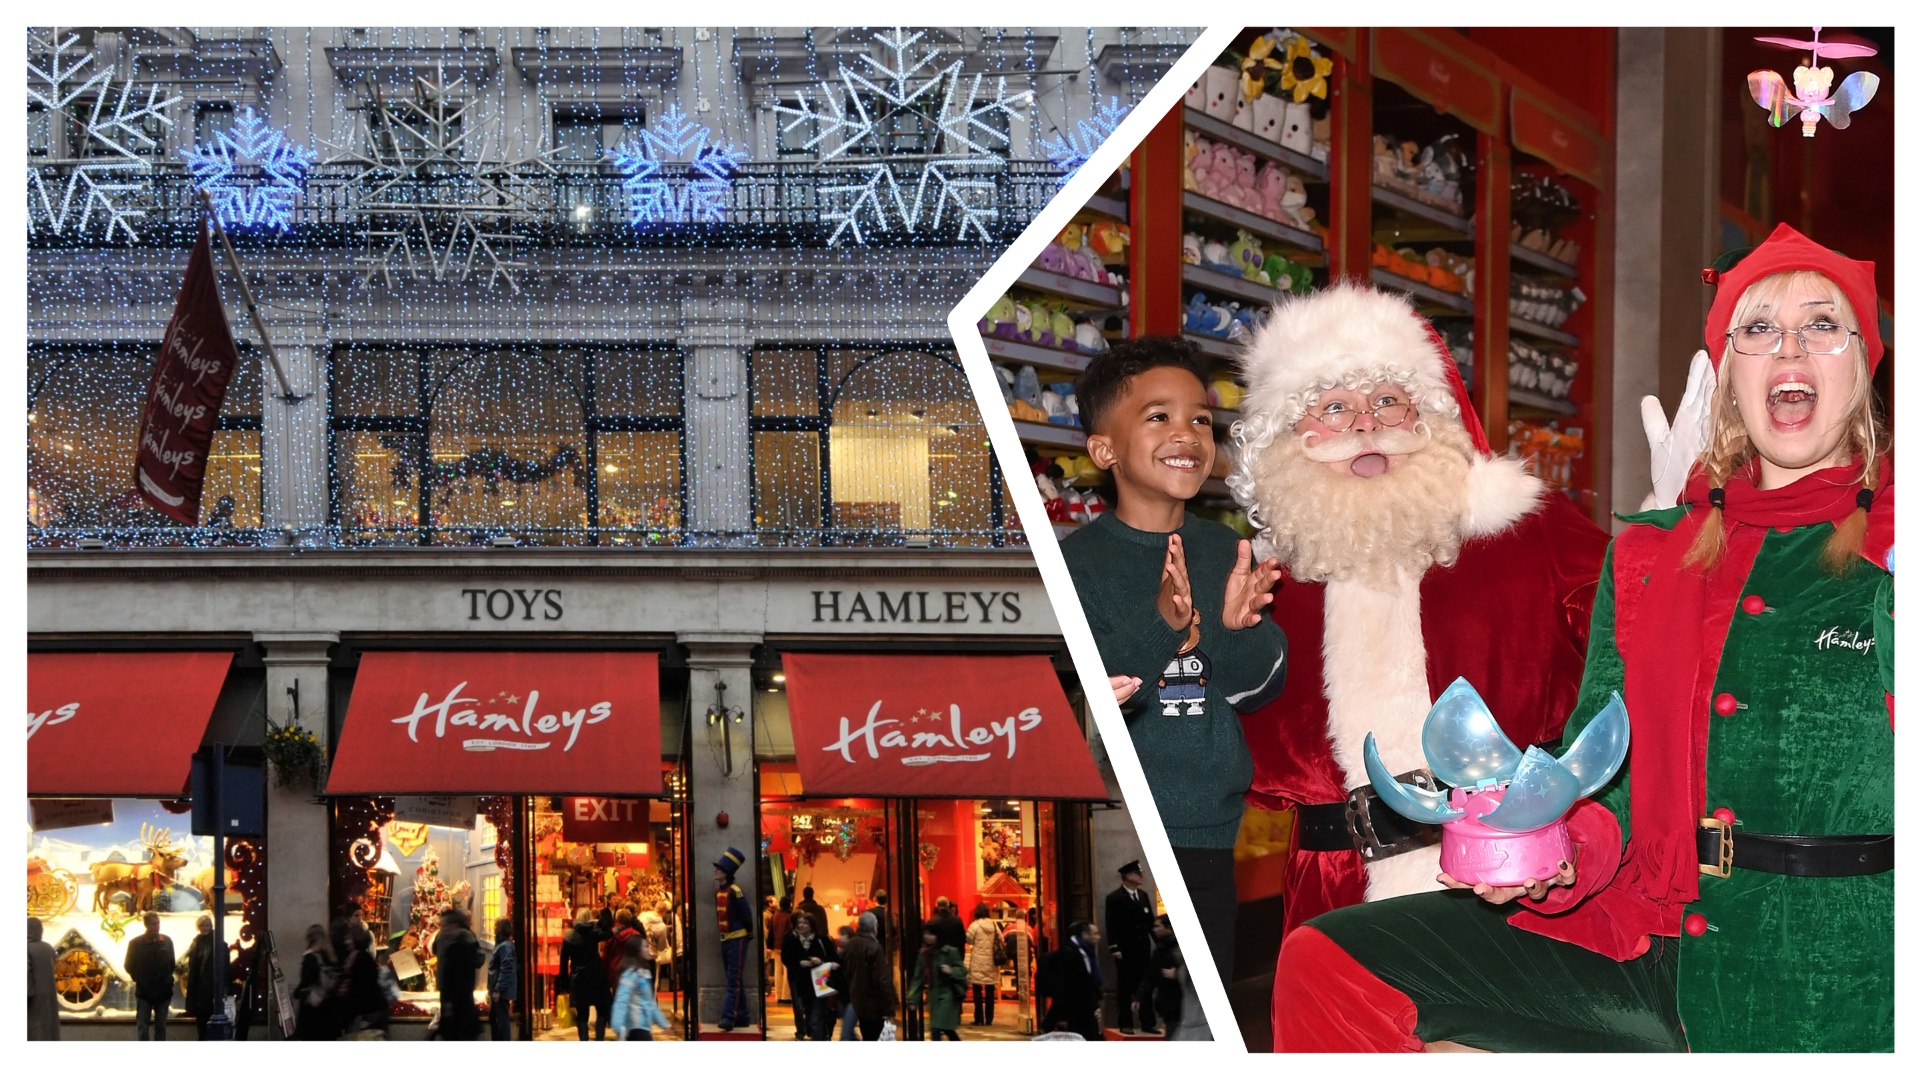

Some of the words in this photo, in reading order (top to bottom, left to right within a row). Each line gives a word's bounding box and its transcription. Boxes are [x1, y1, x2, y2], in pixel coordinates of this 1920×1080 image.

[461, 588, 564, 621] TOYS
[811, 590, 1022, 624] HAMLEYS
[391, 680, 613, 752] Hamleys
[822, 699, 1043, 763] Hamleys
[574, 798, 639, 821] EXIT
